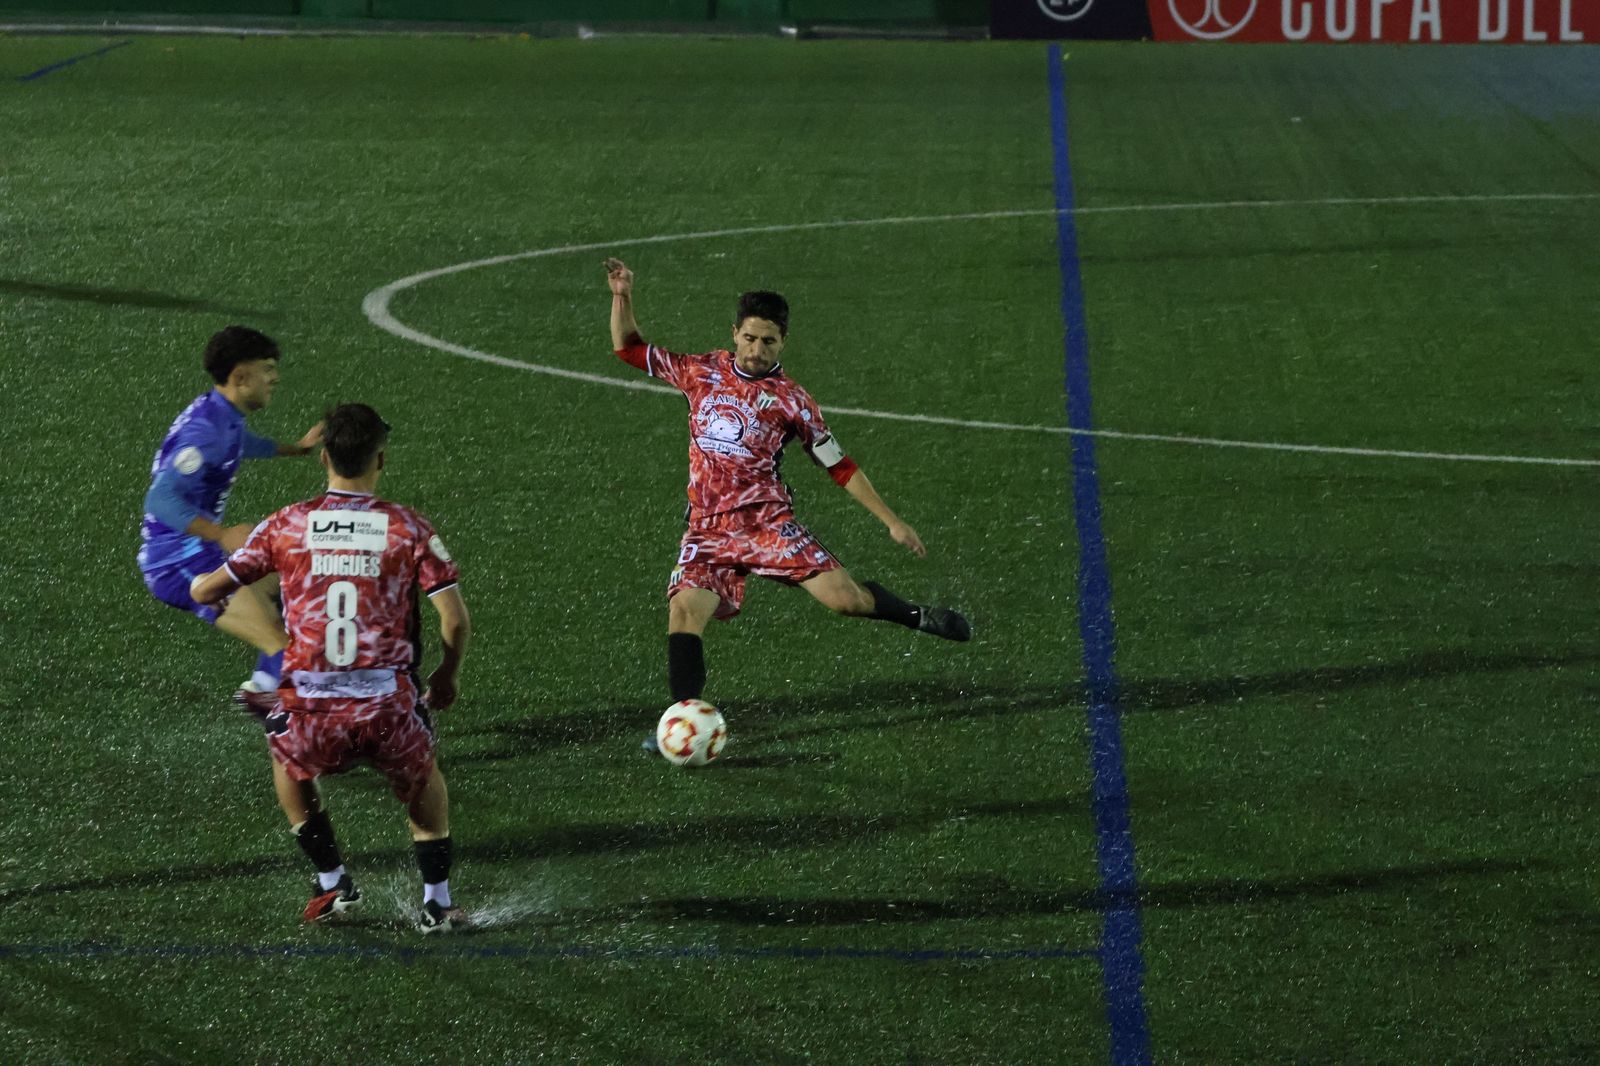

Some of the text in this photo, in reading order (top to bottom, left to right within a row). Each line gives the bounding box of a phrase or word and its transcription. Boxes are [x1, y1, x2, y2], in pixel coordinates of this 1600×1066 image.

[1281, 0, 1442, 40] COPA
[311, 534, 354, 543] COTRIPIEL
[355, 528, 386, 536] HESSEN
[311, 553, 381, 578] BOIGUES
[325, 581, 358, 667] 8
